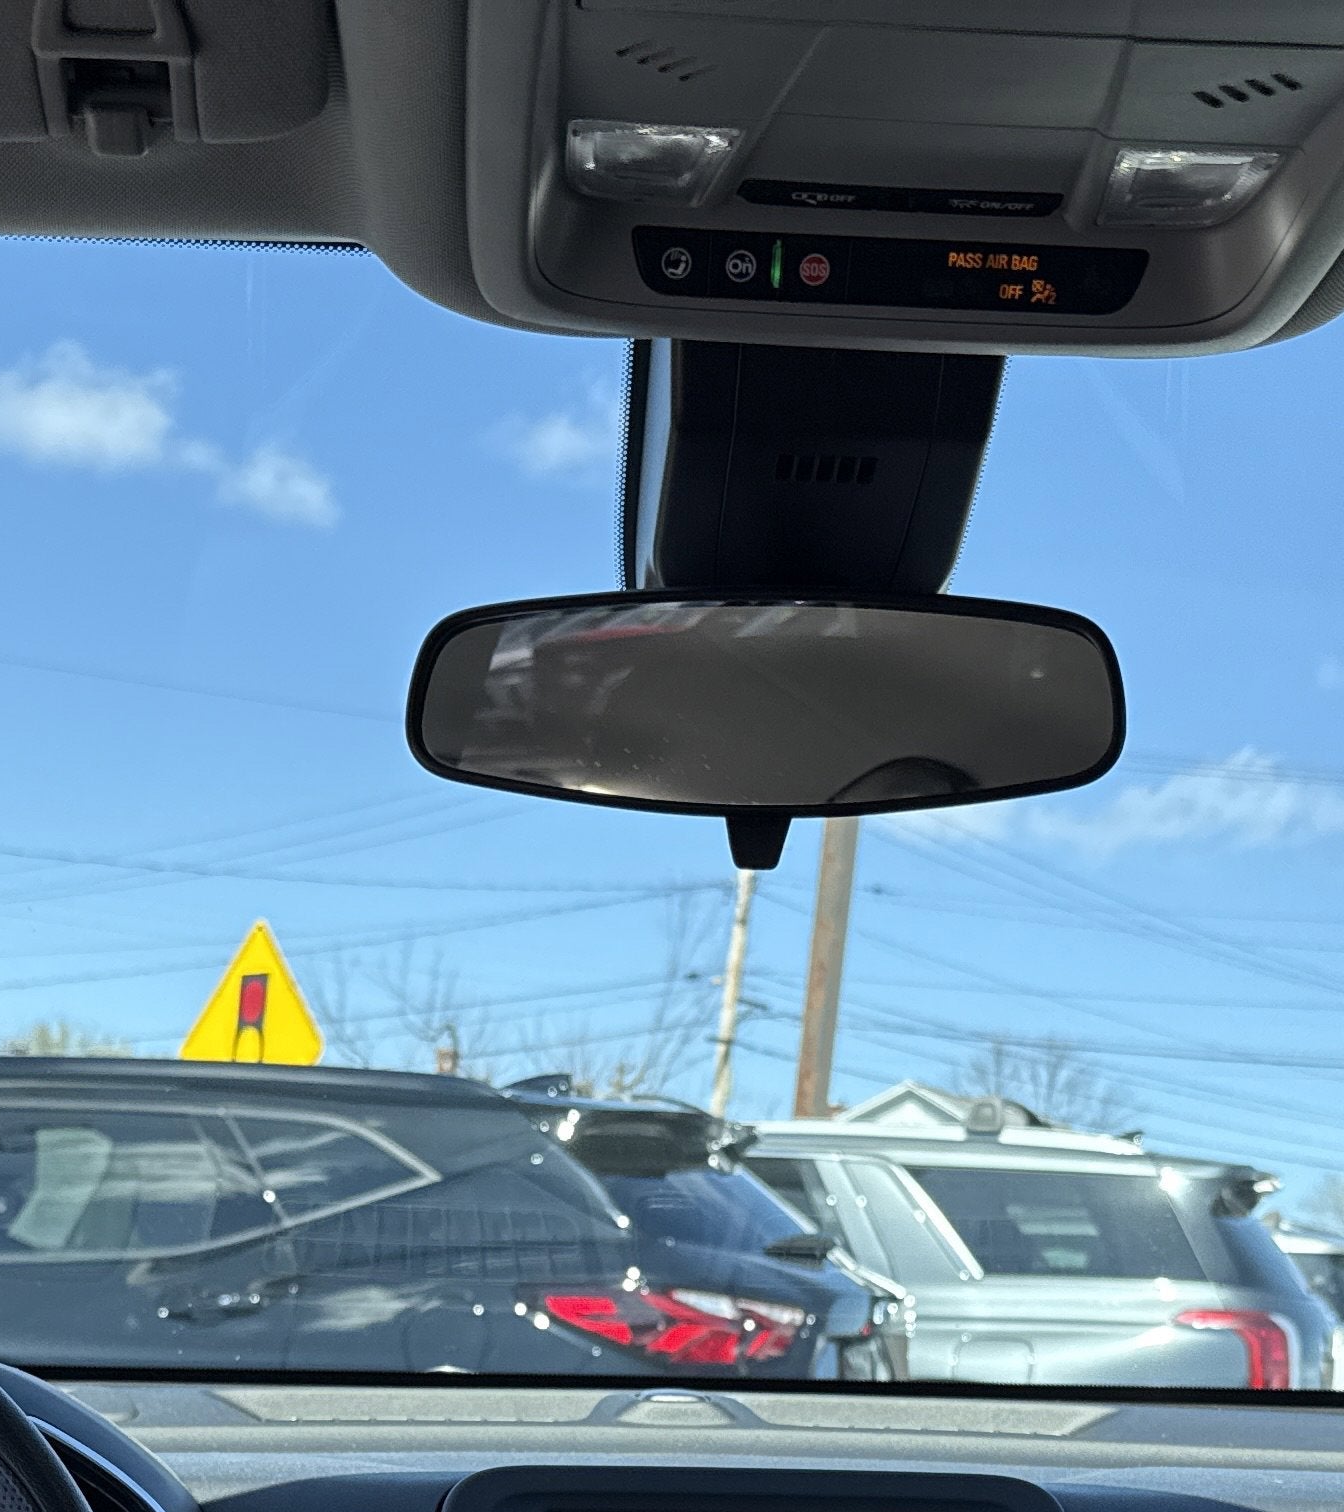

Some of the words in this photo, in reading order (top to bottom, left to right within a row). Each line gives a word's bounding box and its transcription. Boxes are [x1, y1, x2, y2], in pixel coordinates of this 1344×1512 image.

[948, 252, 983, 270] PASS
[985, 254, 1009, 270] AIR
[1010, 254, 1039, 271] BAG
[803, 263, 827, 277] SOS
[999, 284, 1025, 300] OFF
